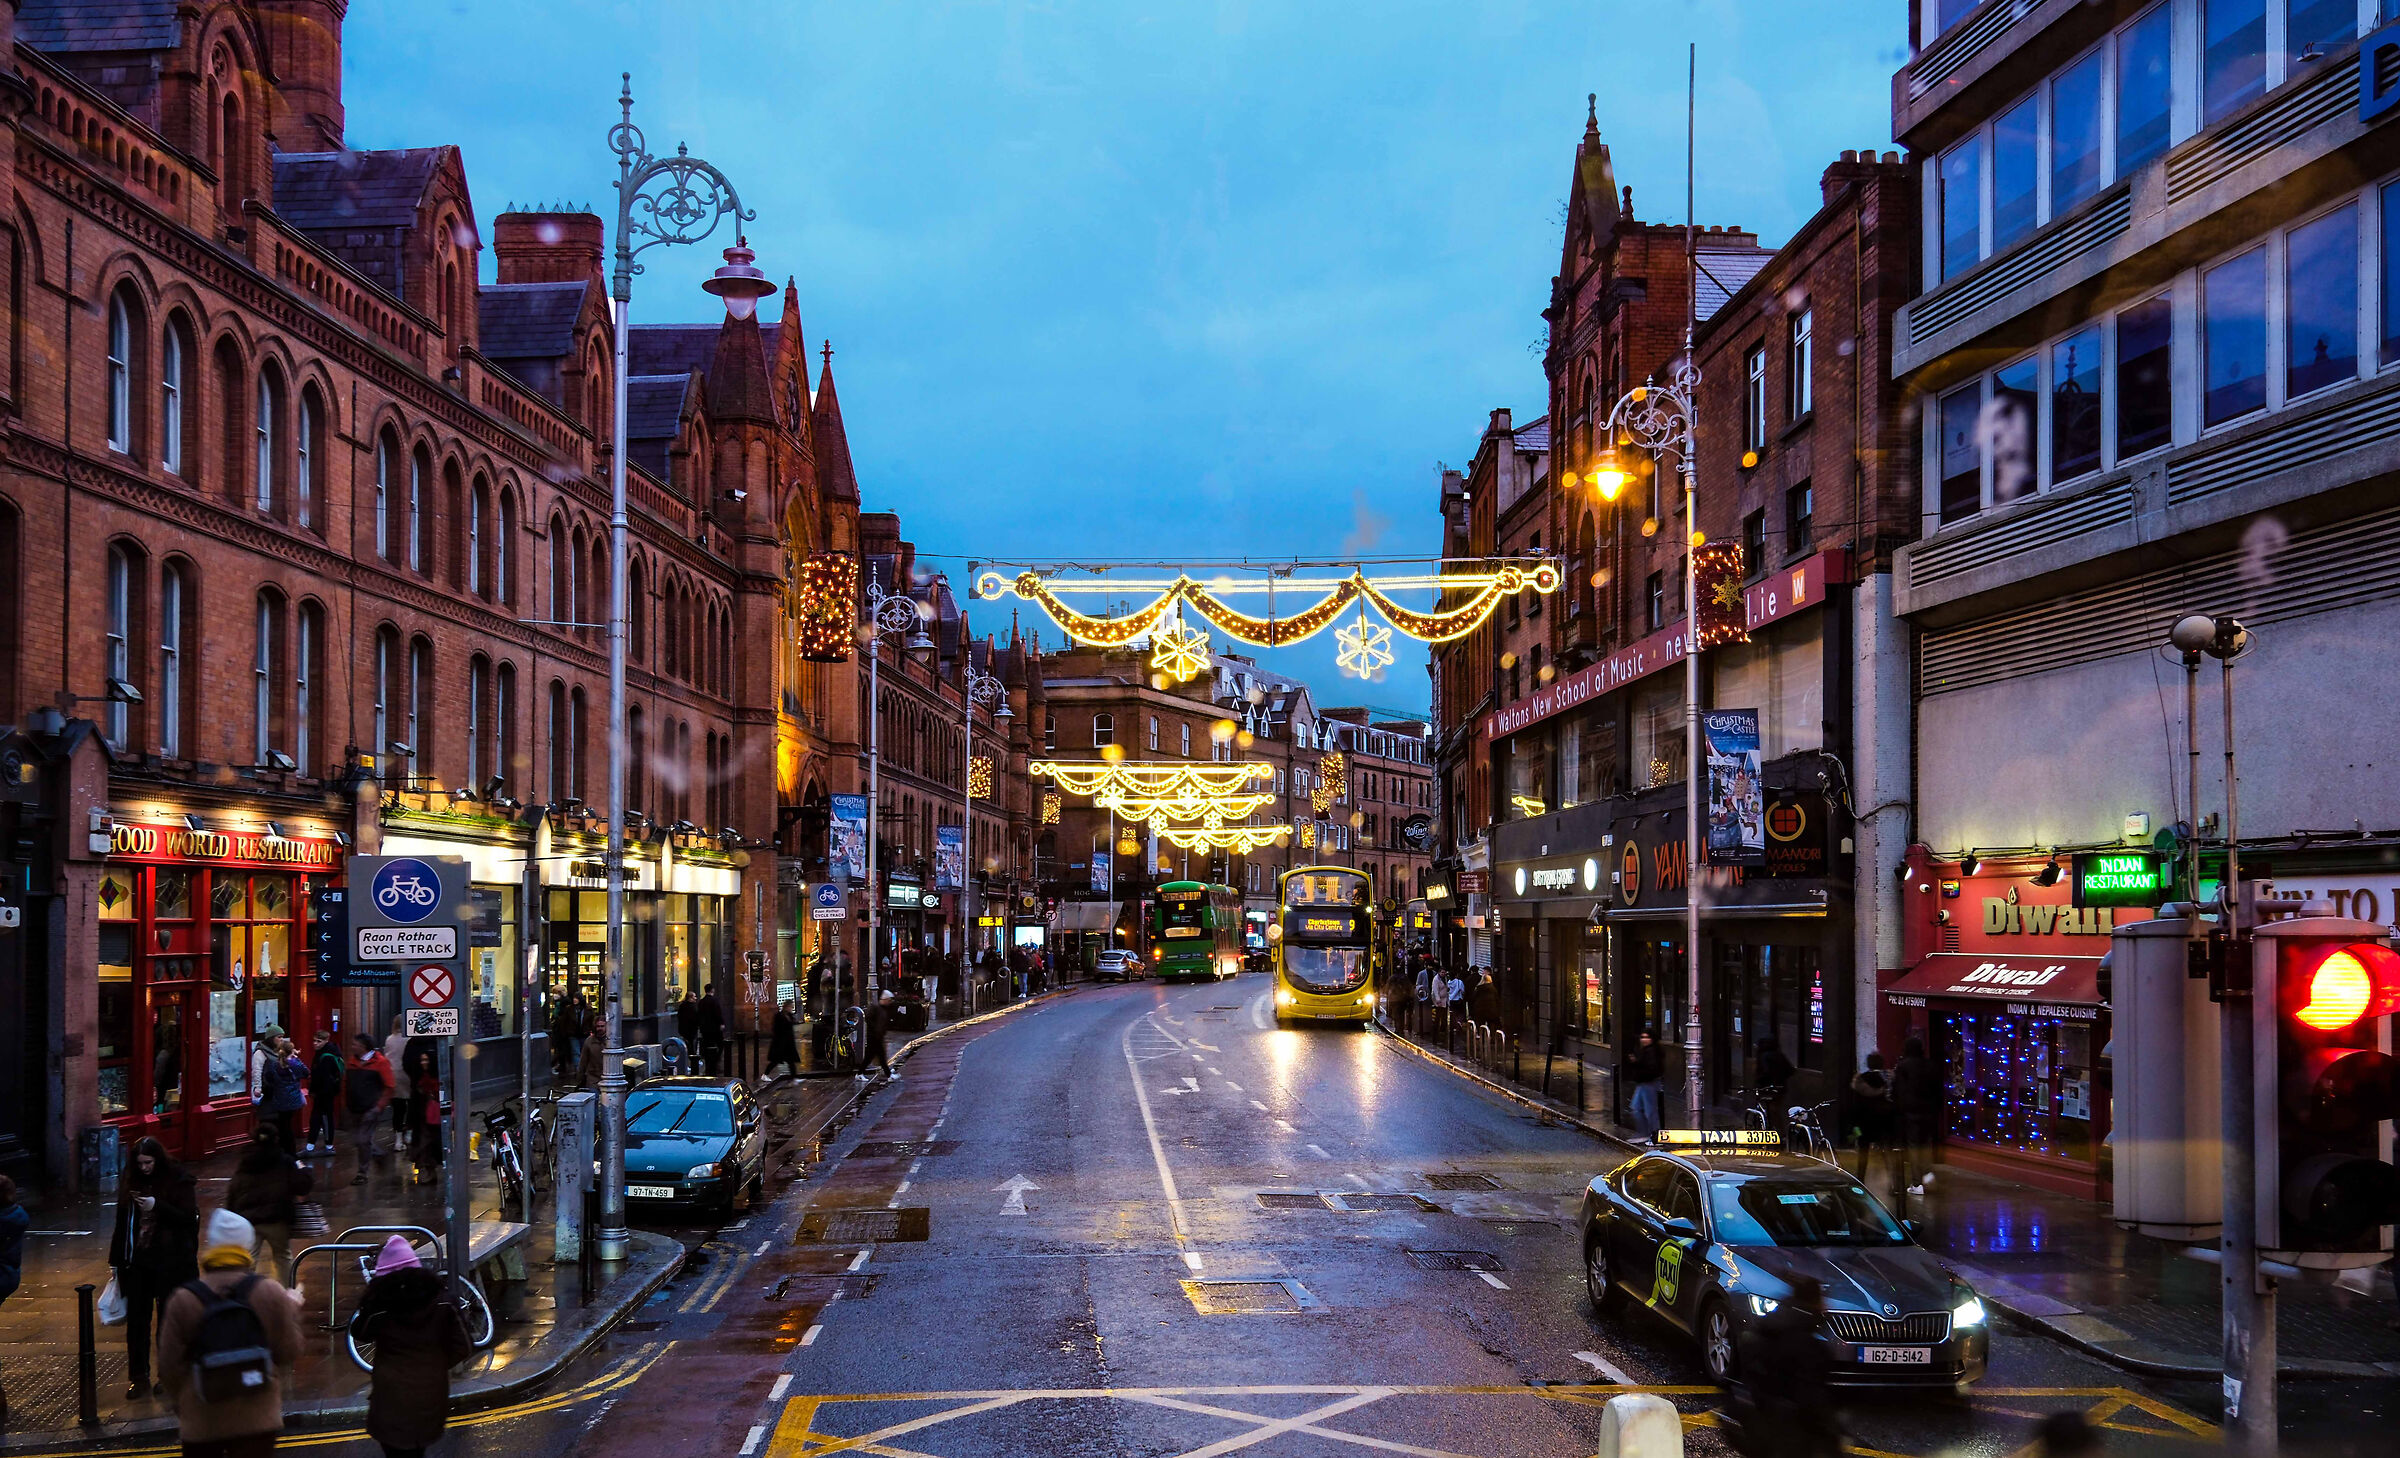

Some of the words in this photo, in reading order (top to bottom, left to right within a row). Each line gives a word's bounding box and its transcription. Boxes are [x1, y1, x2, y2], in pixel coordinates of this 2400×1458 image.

[1498, 706, 1530, 733] Waltons
[1532, 695, 1551, 720] New
[1555, 672, 1590, 709] School
[1594, 666, 1605, 692] of
[1610, 648, 1644, 686] Music
[1704, 715, 1755, 730] CHRISTMAS
[164, 830, 230, 857] WORLD
[235, 836, 334, 865] RESTAURANT
[2099, 857, 2142, 873] INDIAN
[2084, 874, 2158, 889] RESTAURANT
[1349, 919, 1356, 931] 9
[363, 932, 393, 943] Raon
[397, 931, 438, 942] Rothar
[363, 945, 406, 955] CYCLE
[409, 943, 452, 954] TRACK
[1961, 963, 2066, 985] Diwali
[2007, 1003, 2028, 1015] INDIAN
[2030, 1005, 2036, 1015] &
[2037, 1005, 2070, 1018] NEPALESE
[2070, 1008, 2097, 1019] CUISINE
[1701, 1130, 1735, 1143] TAXI
[1747, 1131, 1778, 1143] 33765
[633, 1188, 668, 1197] 97-TN-459
[1658, 1257, 1677, 1286] TAXI
[1871, 1350, 1924, 1363] 162-D-5142
